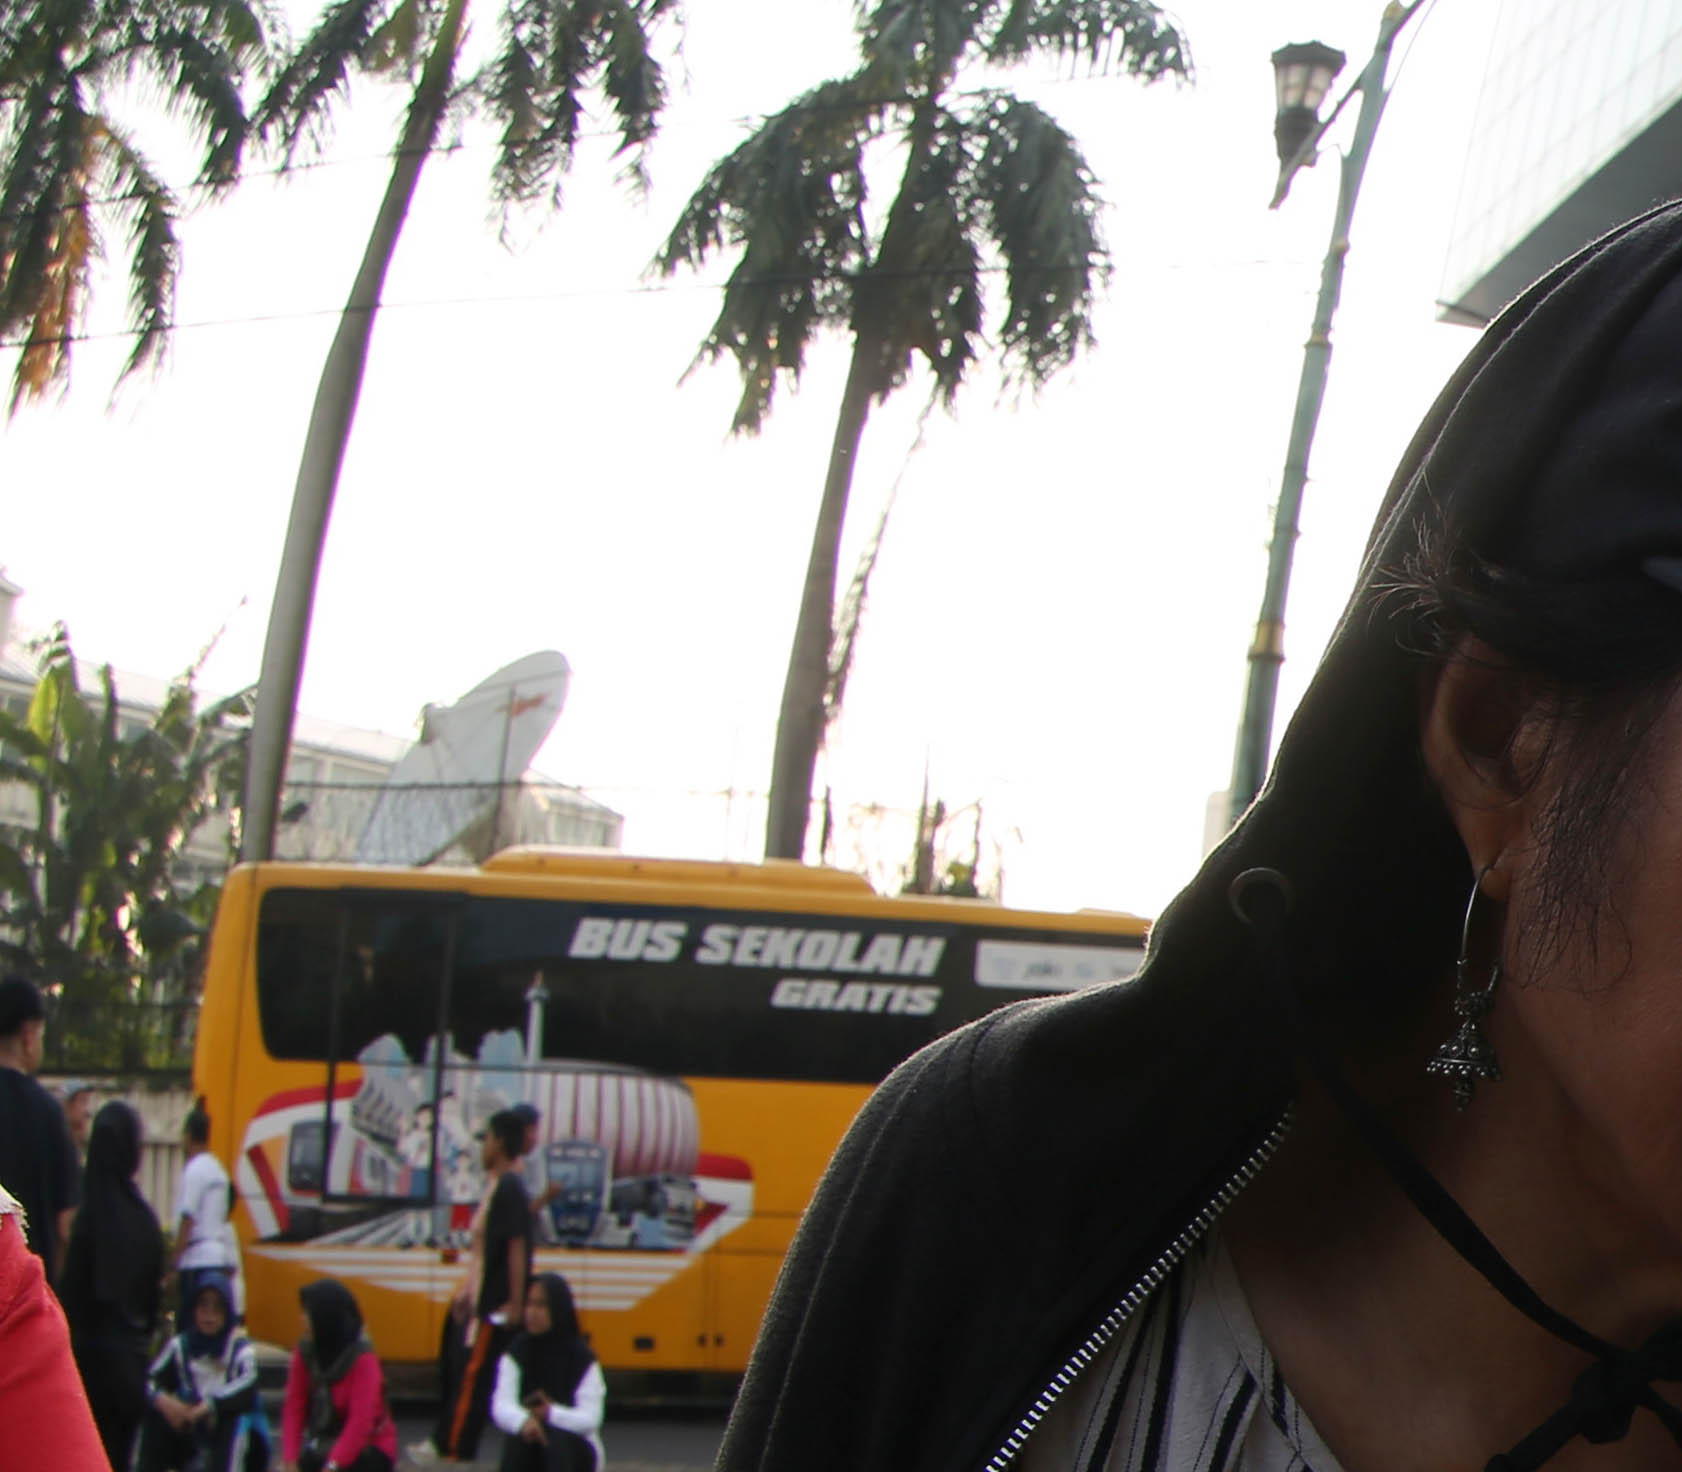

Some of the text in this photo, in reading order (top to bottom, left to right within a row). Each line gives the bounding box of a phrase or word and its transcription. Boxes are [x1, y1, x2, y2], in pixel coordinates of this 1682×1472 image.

[568, 916, 946, 977] BUS SEKOLAH
[770, 978, 943, 1015] GRATIS
